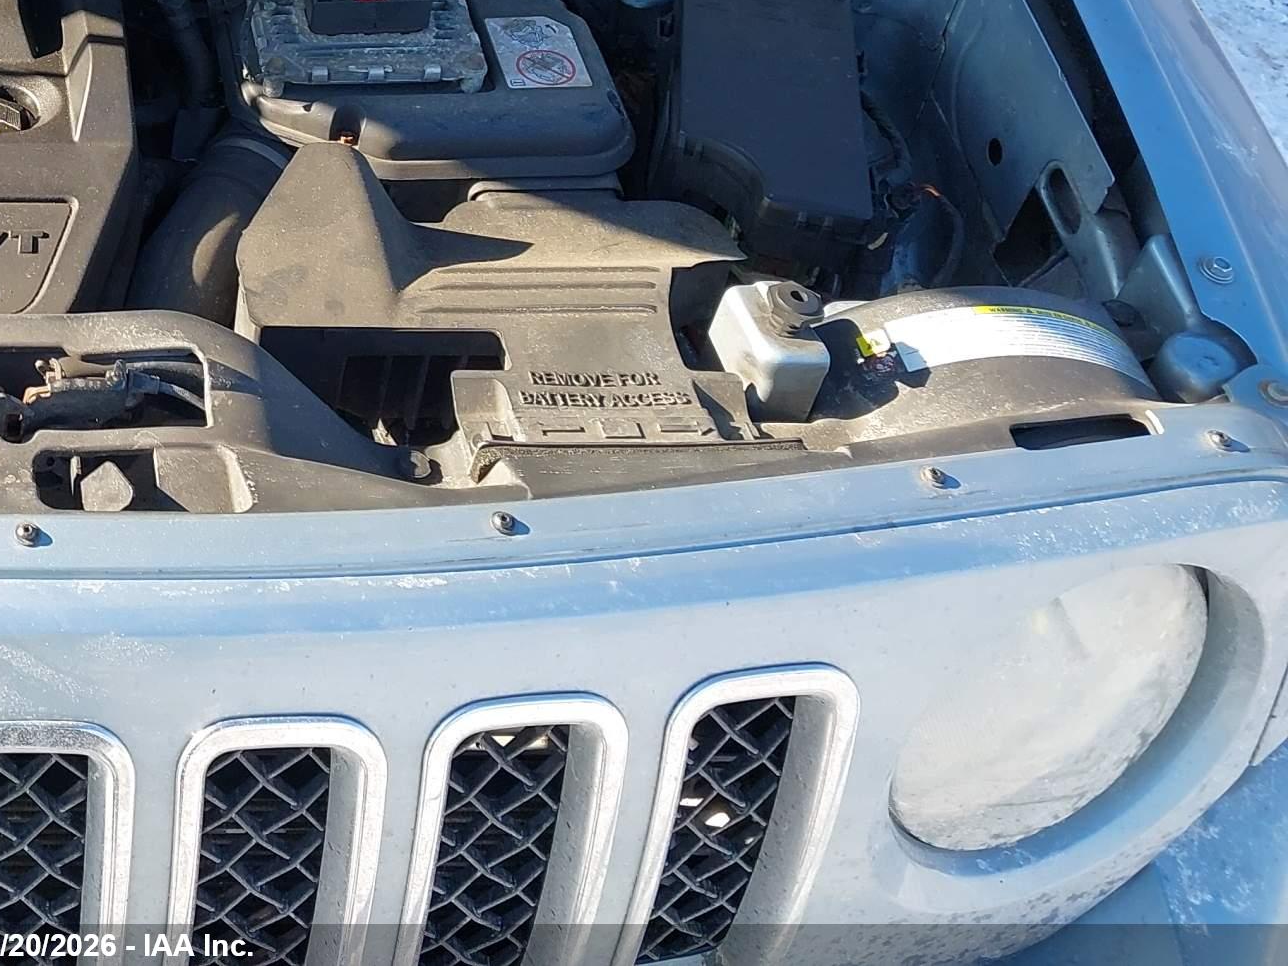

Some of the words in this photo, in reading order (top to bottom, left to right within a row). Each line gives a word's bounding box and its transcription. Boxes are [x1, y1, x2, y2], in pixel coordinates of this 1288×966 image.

[529, 370, 616, 387] REMOVE
[617, 371, 662, 386] FOR
[519, 390, 606, 408] BATTERY
[611, 391, 693, 408] ACCESS
